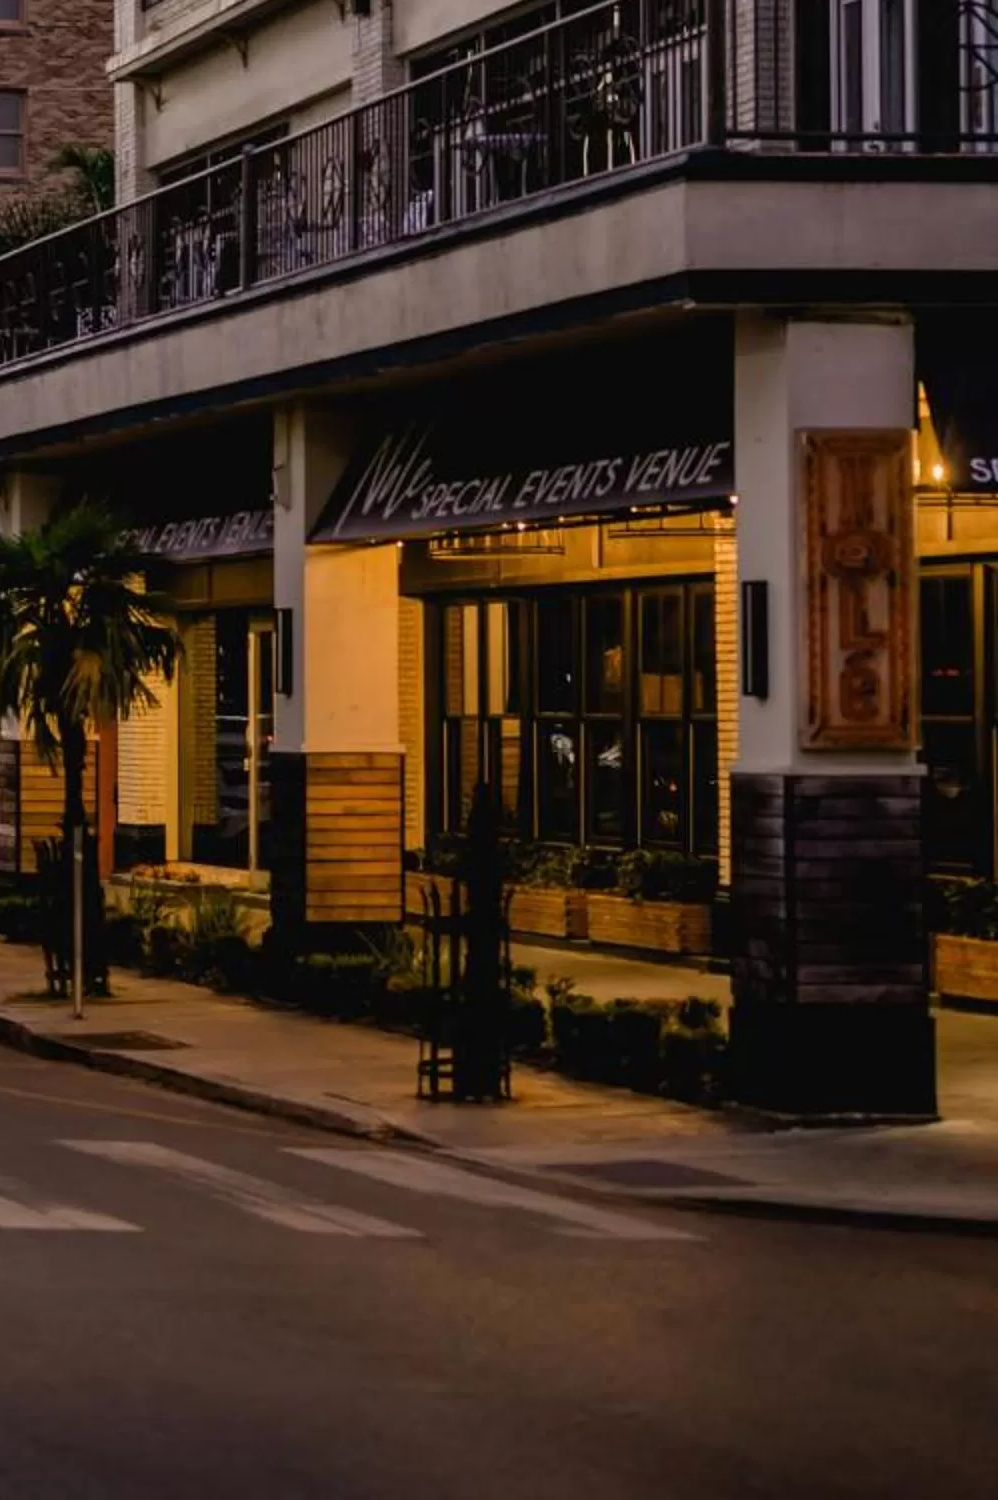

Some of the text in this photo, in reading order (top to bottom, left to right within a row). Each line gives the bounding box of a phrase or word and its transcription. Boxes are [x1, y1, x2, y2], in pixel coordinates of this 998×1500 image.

[411, 473, 512, 520] SPECIAL
[513, 457, 623, 509] EVENTS
[624, 440, 731, 492] VENUE
